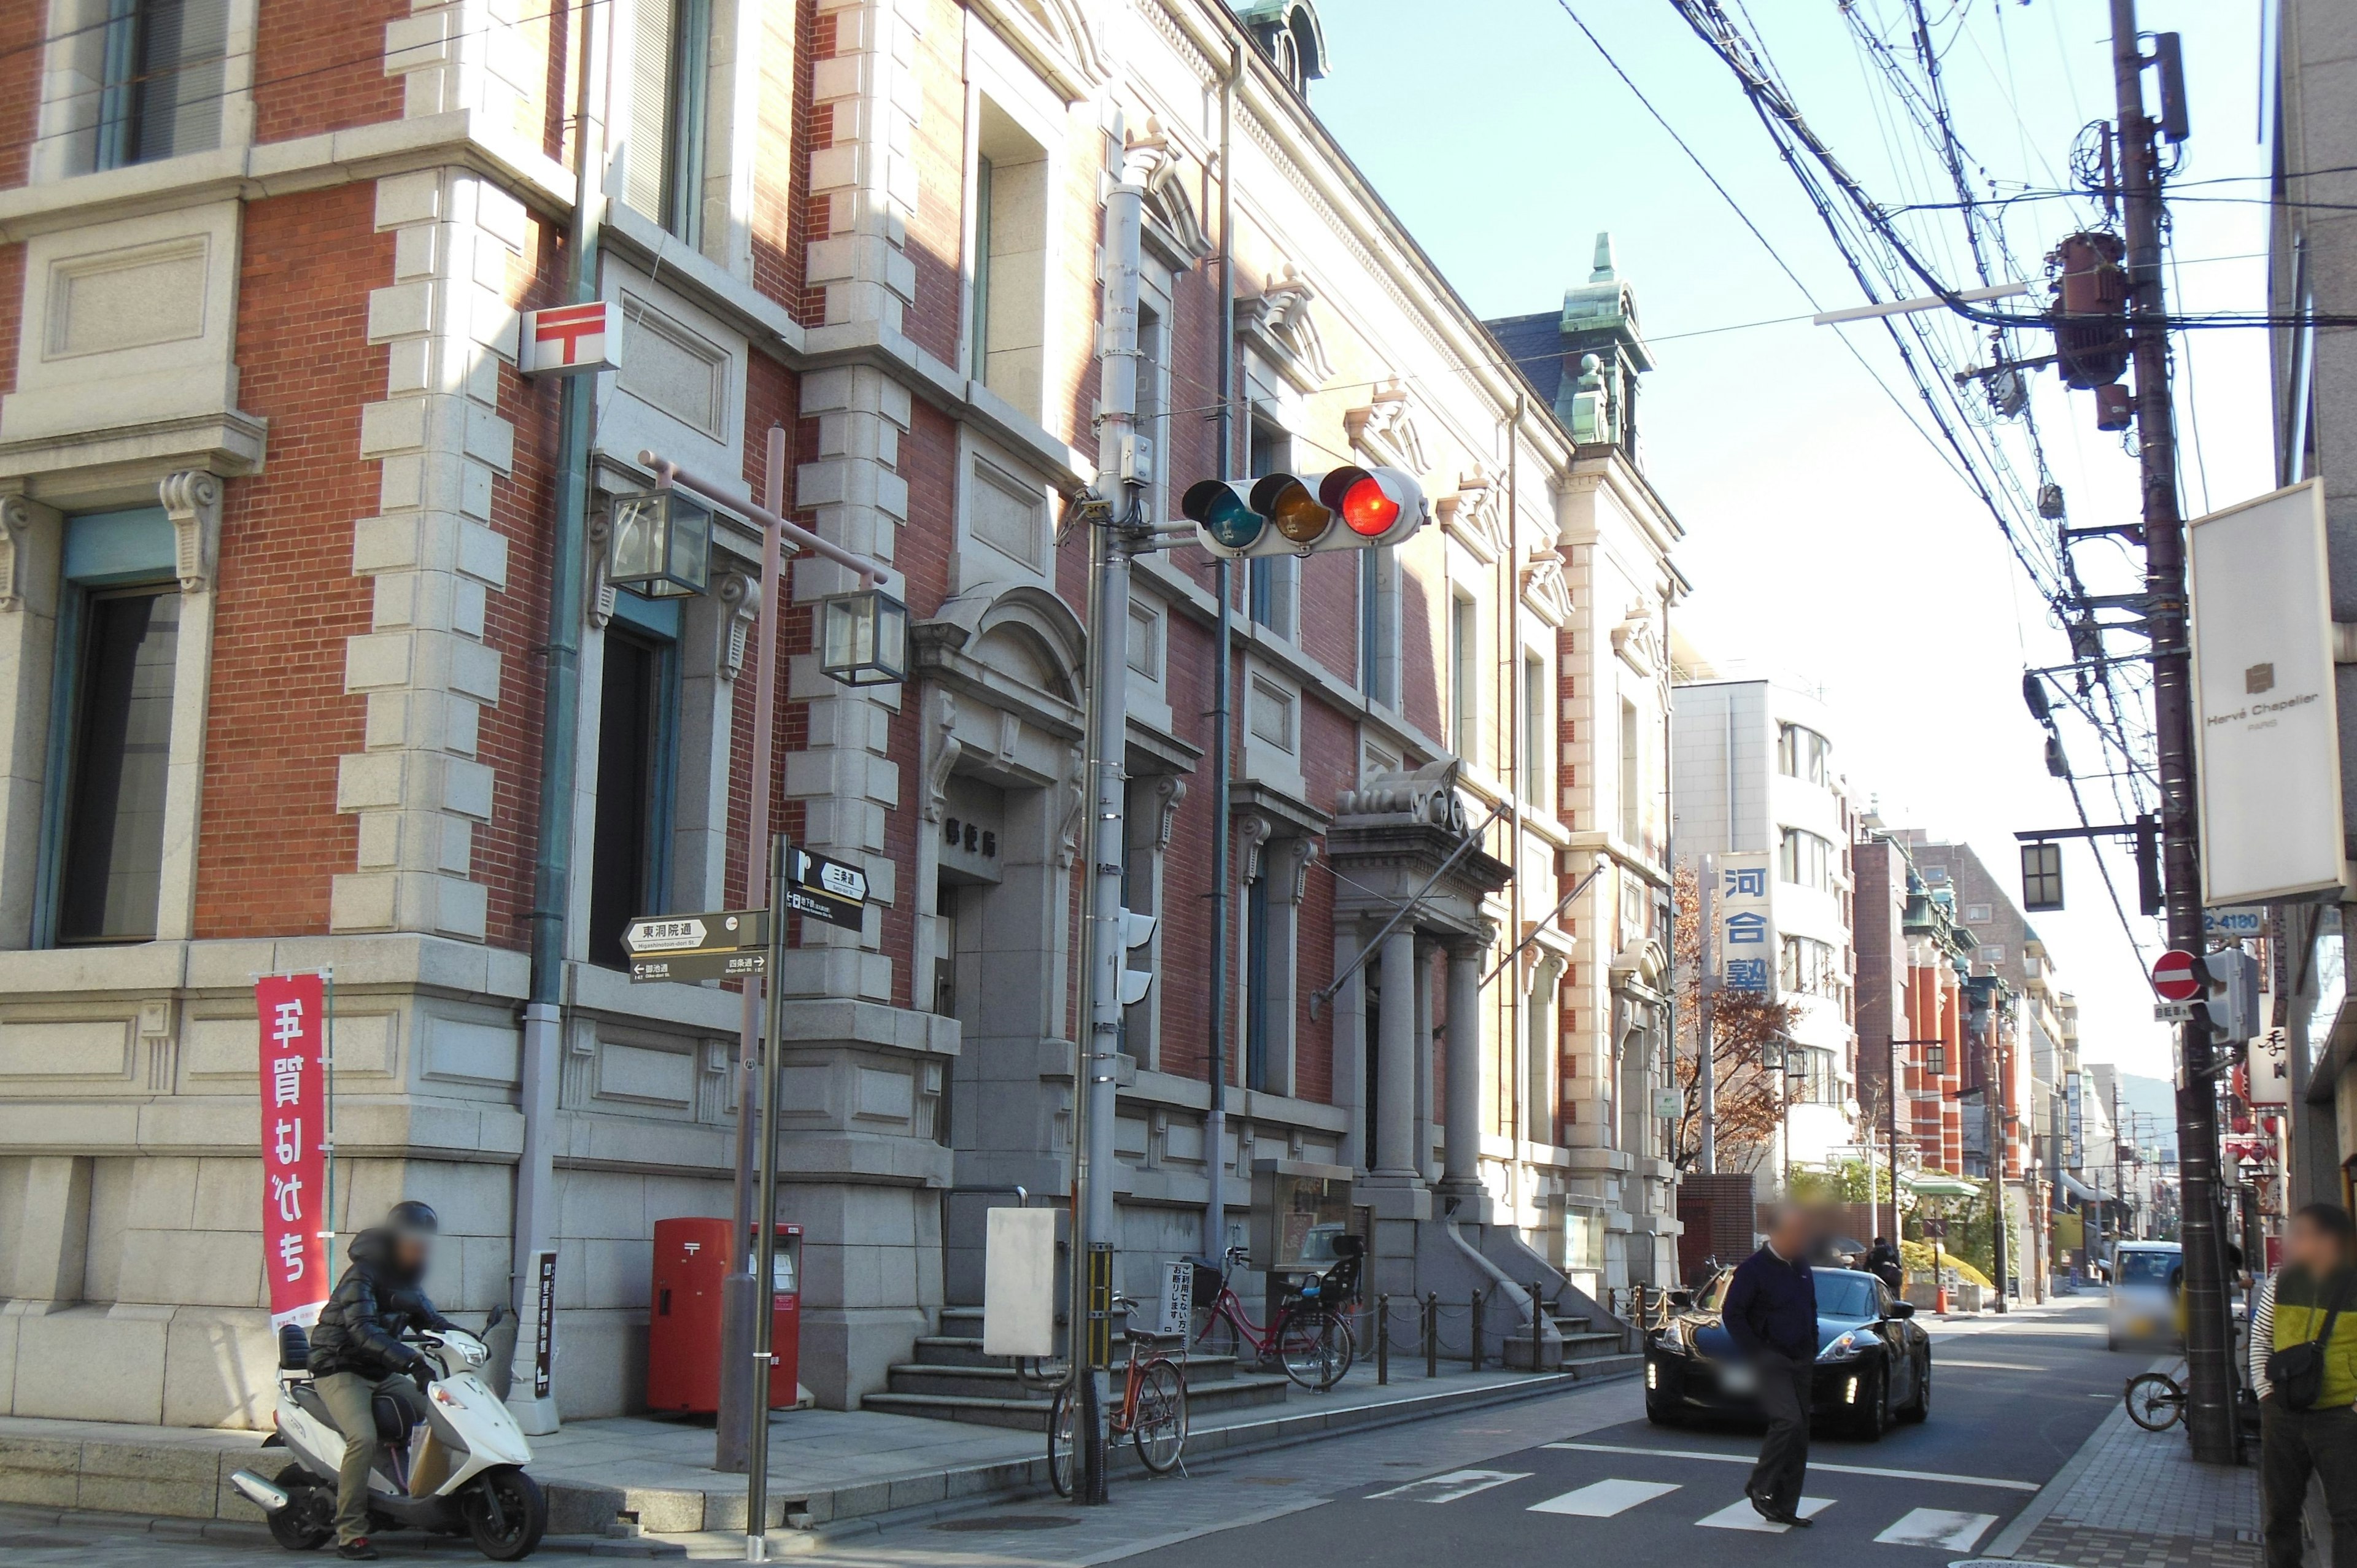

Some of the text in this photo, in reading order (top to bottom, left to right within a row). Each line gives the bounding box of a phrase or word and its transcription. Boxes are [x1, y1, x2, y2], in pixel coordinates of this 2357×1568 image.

[2207, 693, 2320, 727] Hervé Chapelier
[2247, 719, 2278, 732] PARIS
[834, 868, 854, 886] 三条通
[643, 922, 692, 938] 東洞院通
[1725, 868, 1768, 994] 河合塾
[645, 964, 668, 973] 御池通
[729, 958, 753, 968] 四条通
[1170, 1266, 1181, 1319] お断りします
